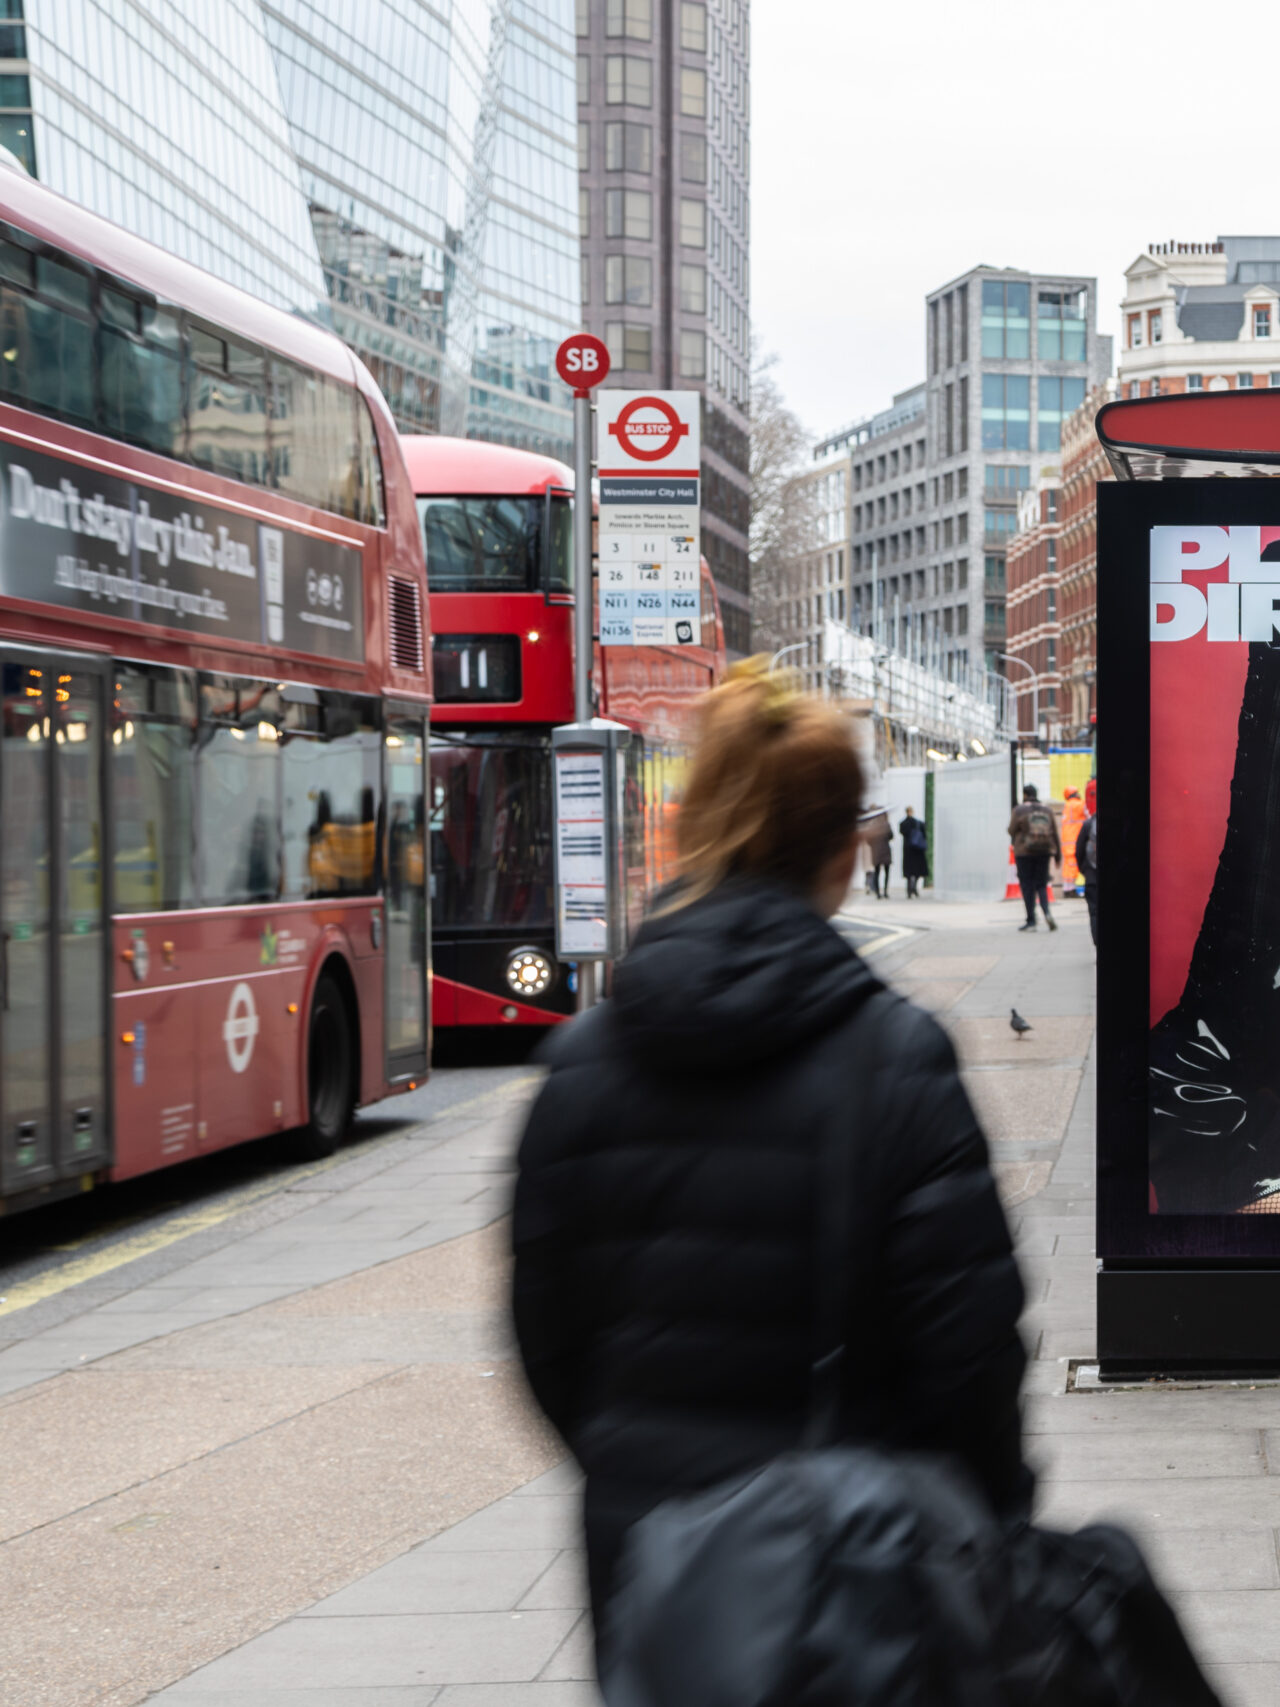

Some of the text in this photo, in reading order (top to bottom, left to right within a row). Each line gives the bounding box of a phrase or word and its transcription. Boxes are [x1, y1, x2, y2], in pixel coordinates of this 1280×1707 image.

[565, 348, 599, 372] SB
[625, 424, 673, 435] BUS STOP
[603, 487, 695, 498] Westminster City Hall
[612, 543, 620, 553] 3
[644, 543, 655, 553] 11
[676, 543, 690, 553] 24
[609, 571, 623, 581] 26
[639, 571, 660, 581] 148
[673, 571, 694, 581] 211
[605, 598, 628, 609] N11
[637, 598, 662, 609] N26
[671, 598, 696, 609] N44
[602, 625, 631, 637] N136
[460, 649, 488, 689] 11
